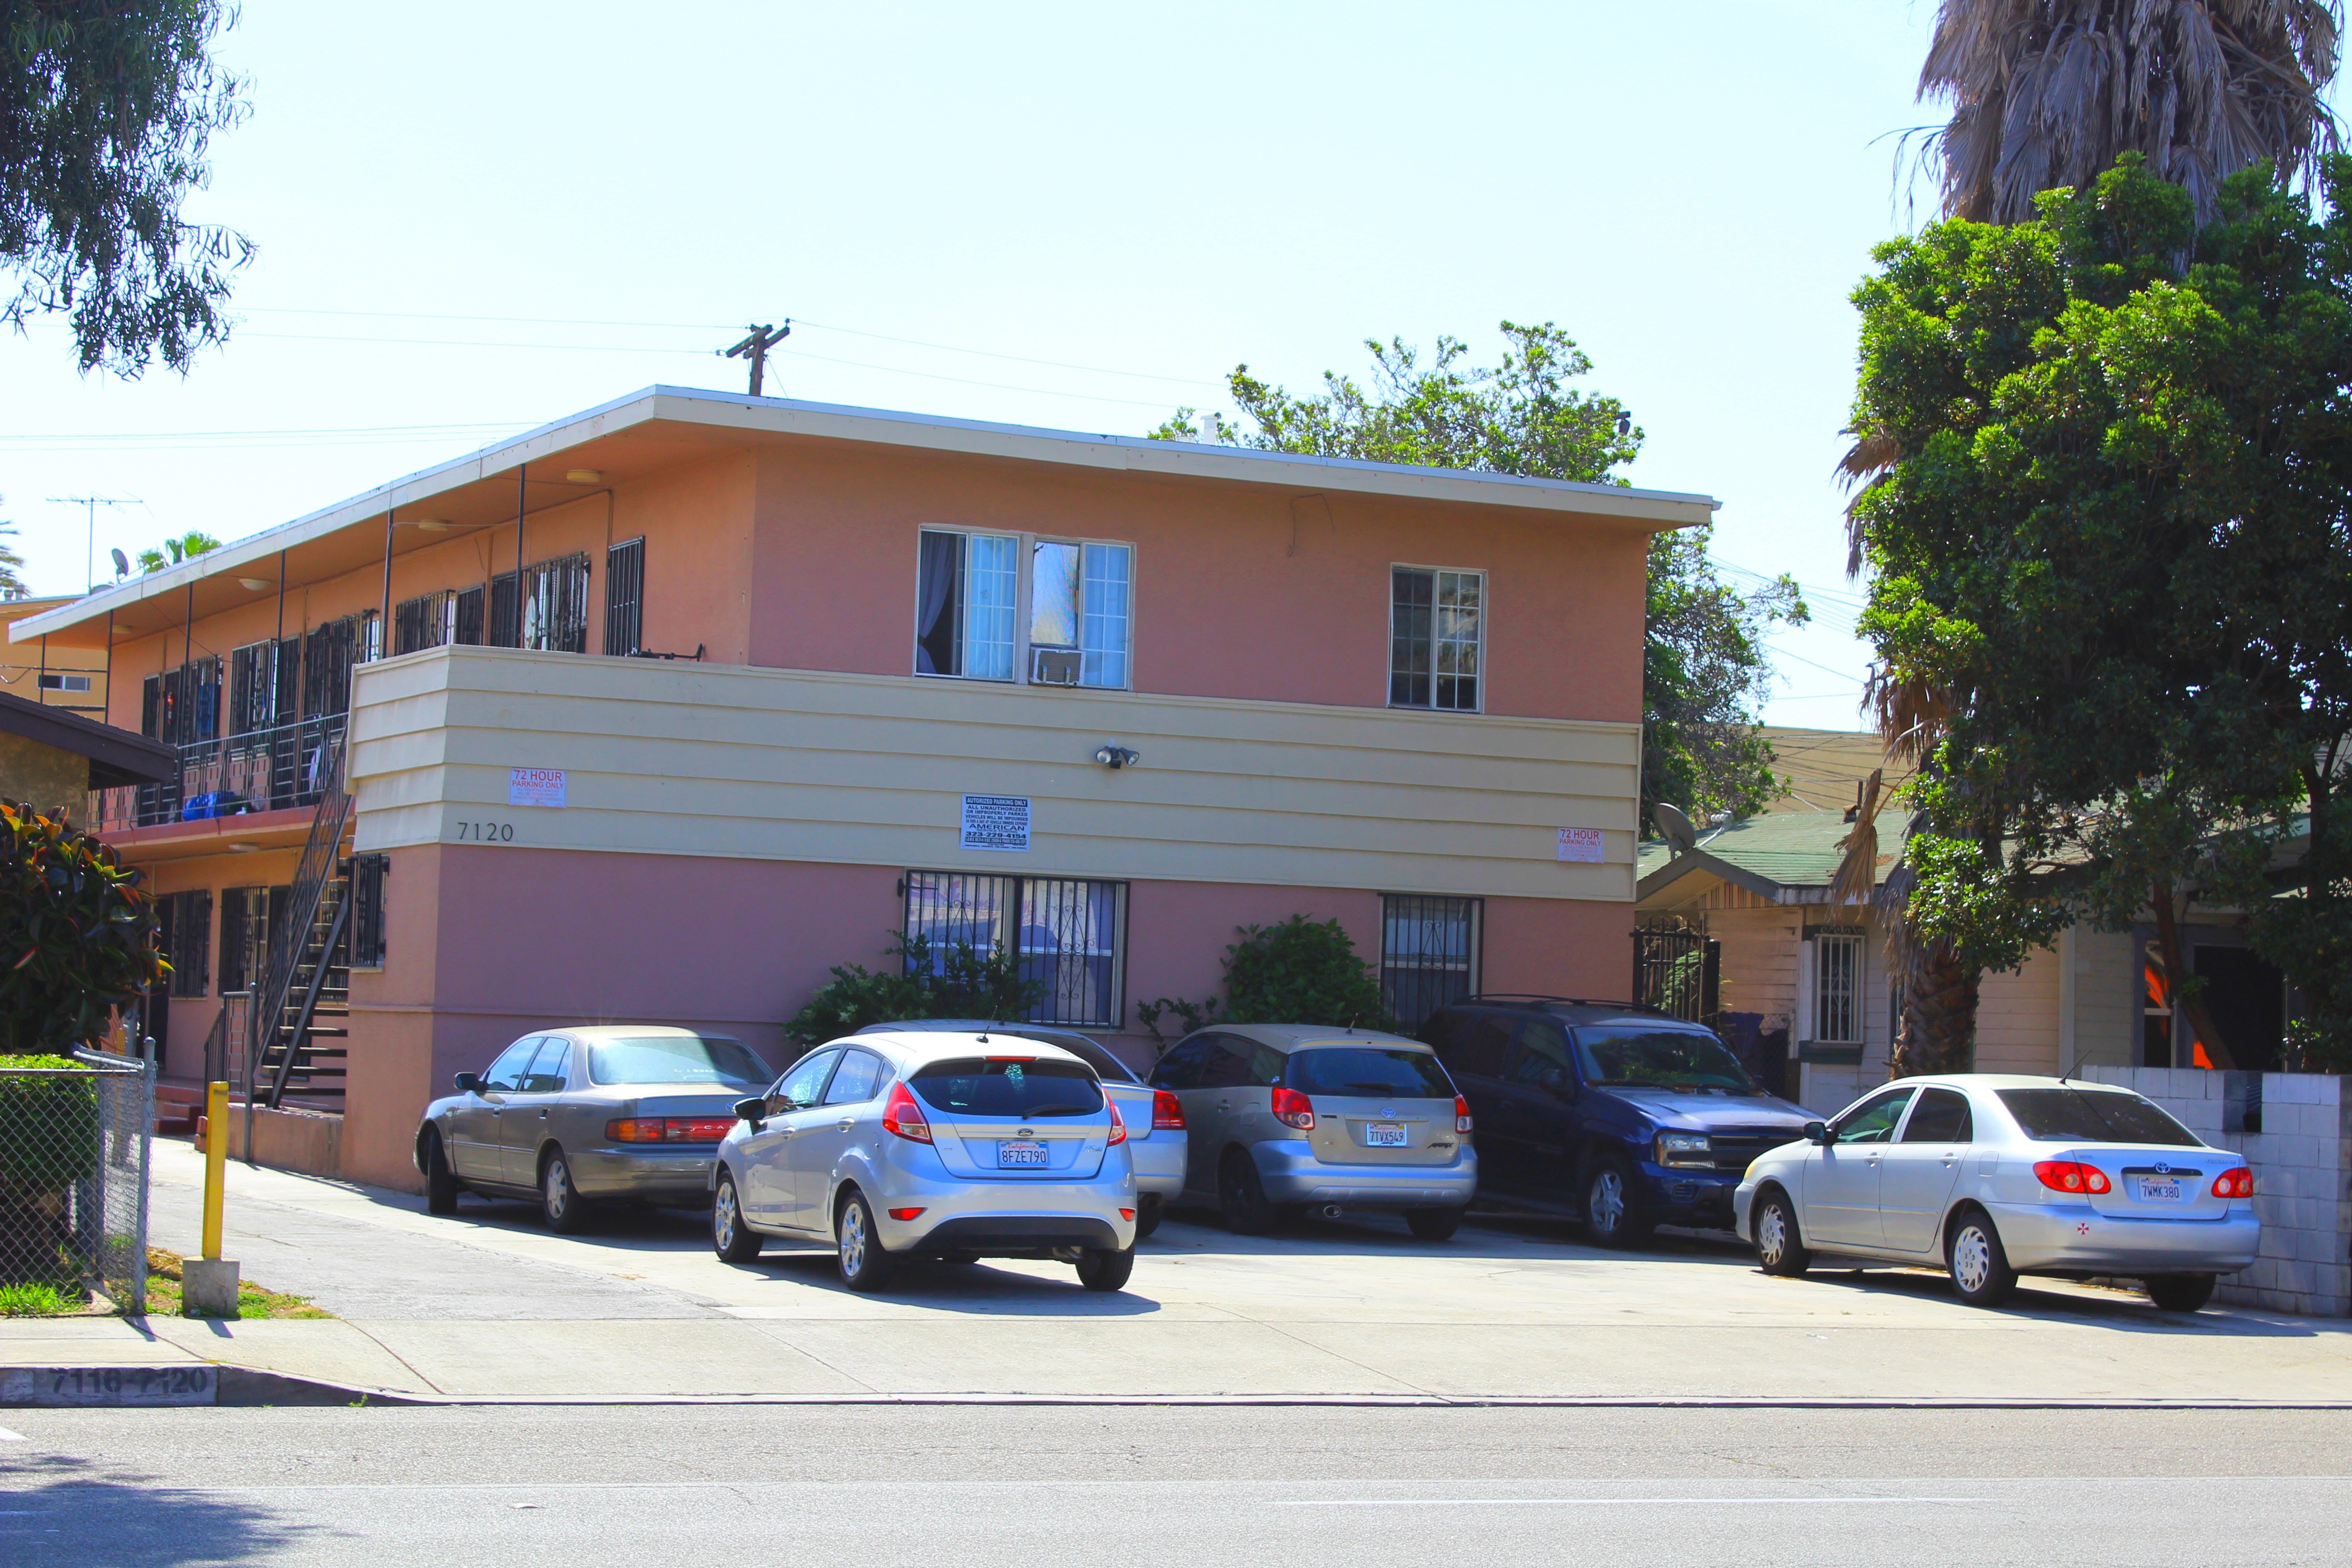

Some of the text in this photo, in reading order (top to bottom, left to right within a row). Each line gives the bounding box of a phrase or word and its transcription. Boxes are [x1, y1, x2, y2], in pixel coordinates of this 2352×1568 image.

[514, 769, 562, 782] 72 HOUR
[458, 822, 513, 841] 7120
[1560, 829, 1599, 839] 72 HOUR
[1370, 1132, 1403, 1142] 7TVX549
[1002, 1151, 1046, 1162] 8FZE790
[2142, 1185, 2179, 1198] 7WMK380
